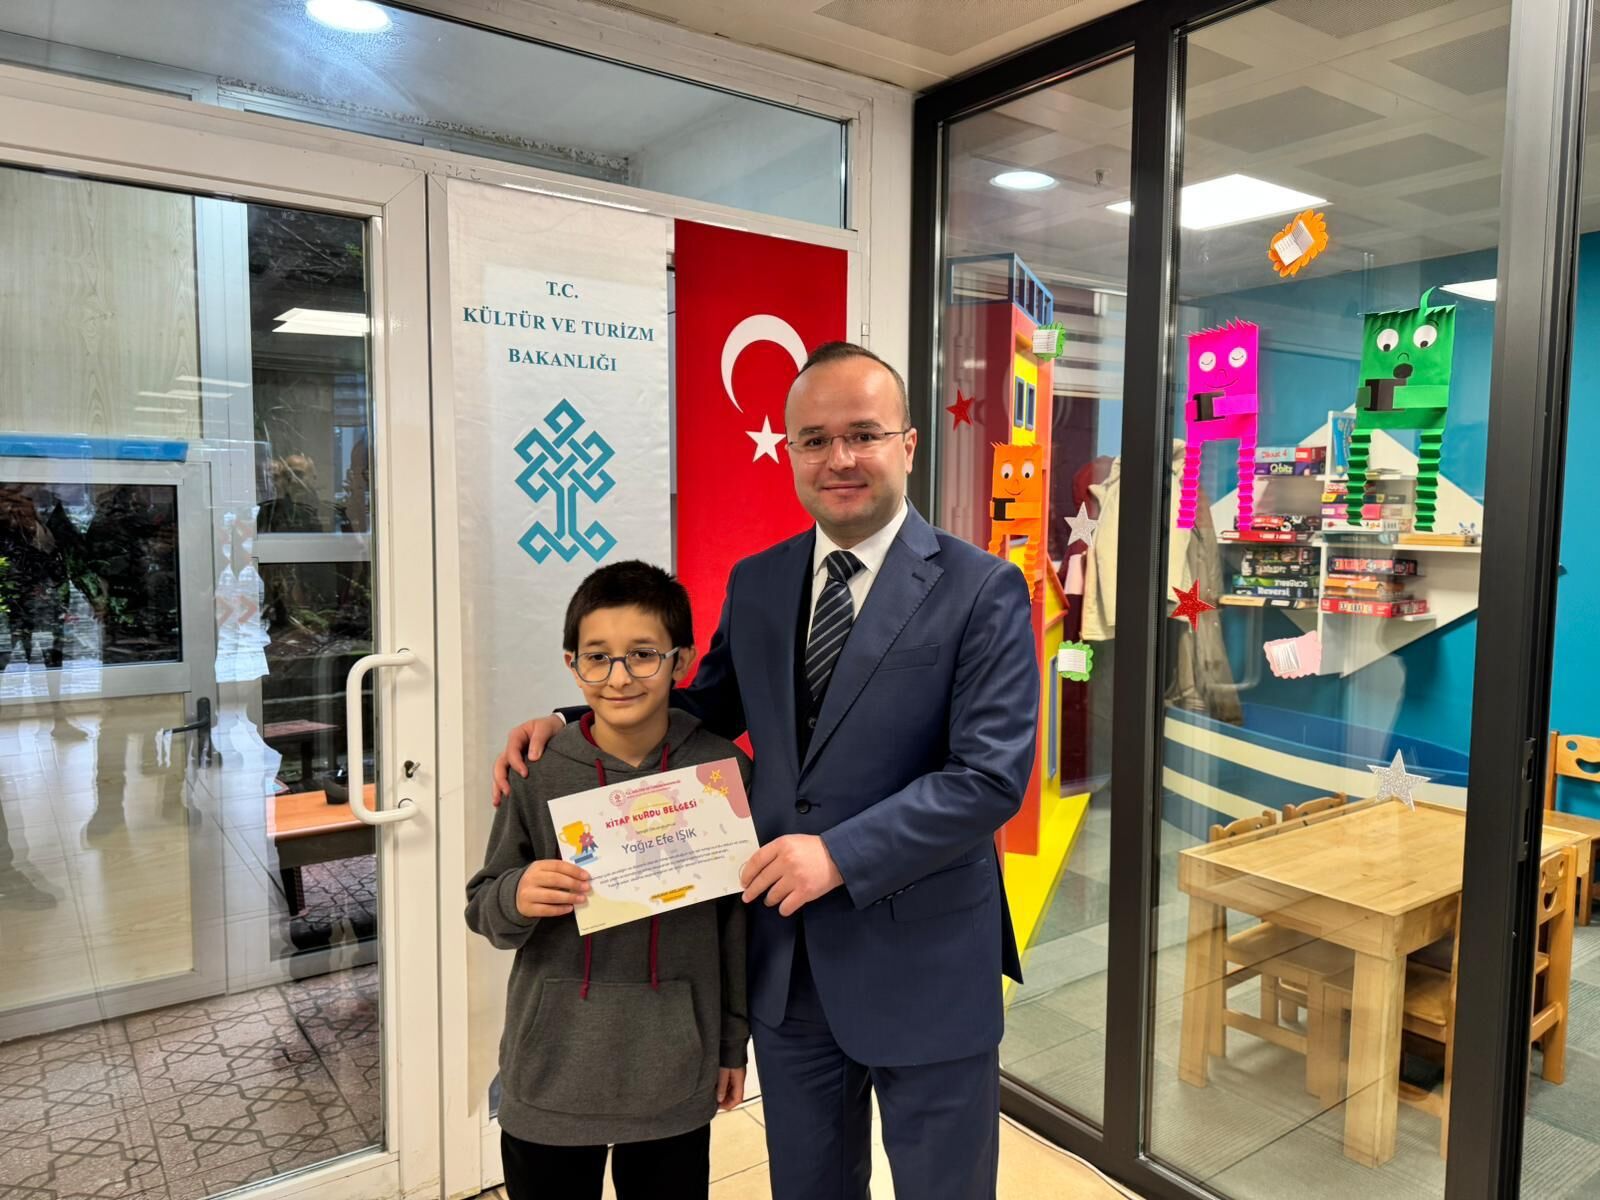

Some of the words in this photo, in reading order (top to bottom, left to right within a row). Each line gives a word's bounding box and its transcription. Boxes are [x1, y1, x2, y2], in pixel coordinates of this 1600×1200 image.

[546, 281, 579, 299] T.C.
[463, 305, 546, 330] KÜLTÜR
[552, 317, 576, 333] VE
[582, 320, 654, 342] TURİZM
[508, 348, 617, 371] BAKANLIĞI
[605, 815, 630, 829] KİTAP
[633, 809, 661, 822] KURDU
[663, 799, 697, 814] BELGESİ
[621, 839, 654, 854] Yağız
[655, 833, 674, 845] Efe
[676, 828, 697, 843] IŞIK
